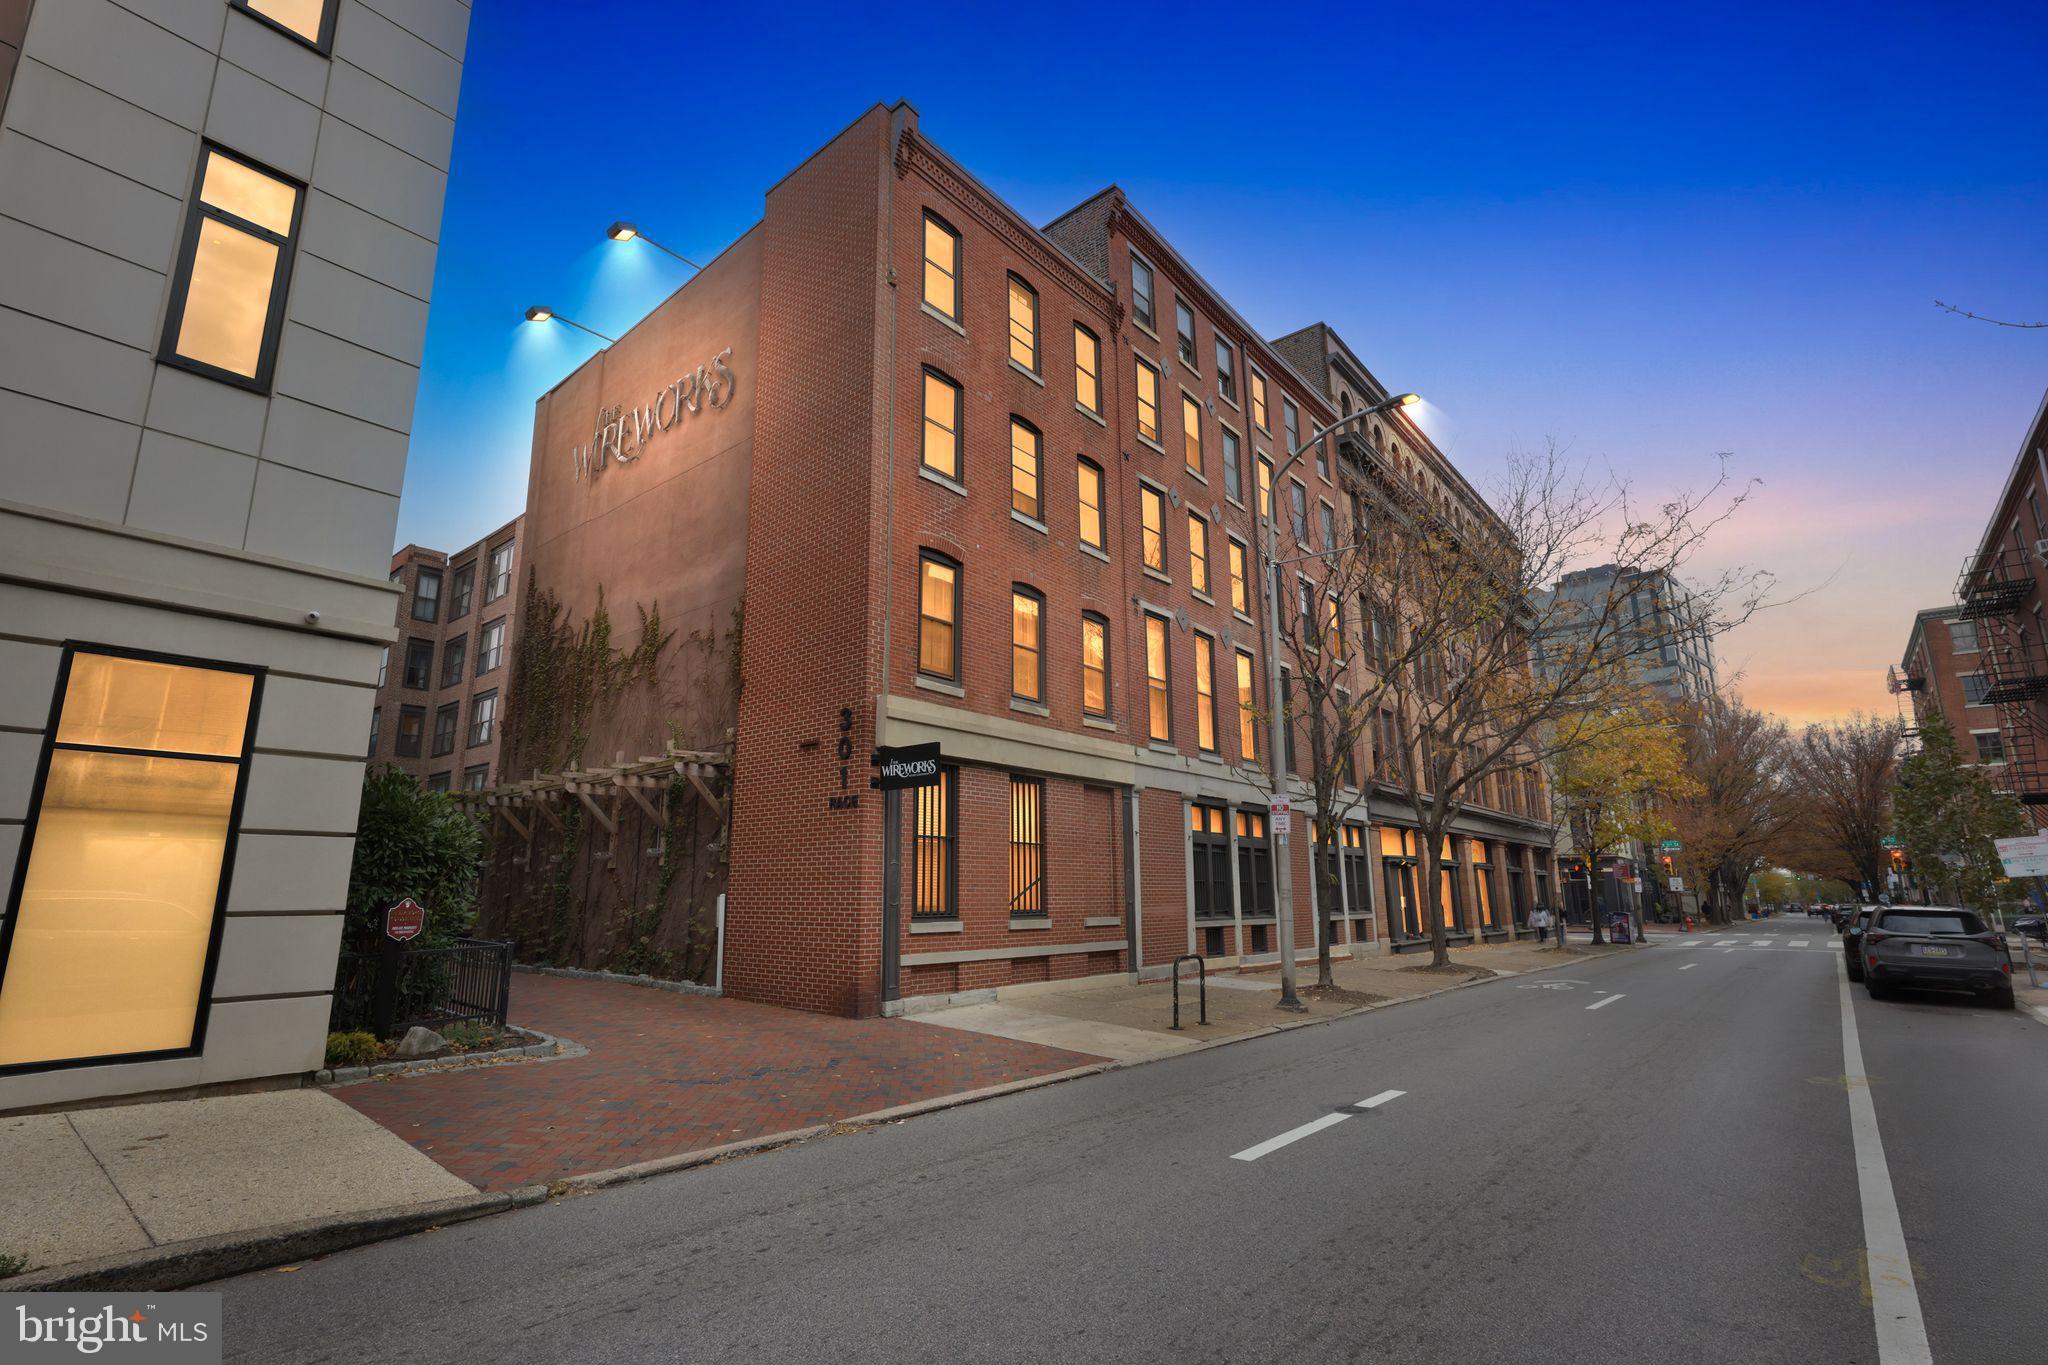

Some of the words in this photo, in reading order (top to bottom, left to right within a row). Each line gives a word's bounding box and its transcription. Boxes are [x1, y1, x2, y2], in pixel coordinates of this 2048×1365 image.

[573, 347, 736, 482] WIREWORKS
[838, 707, 852, 790] 301
[881, 759, 937, 778] WIREWORKS
